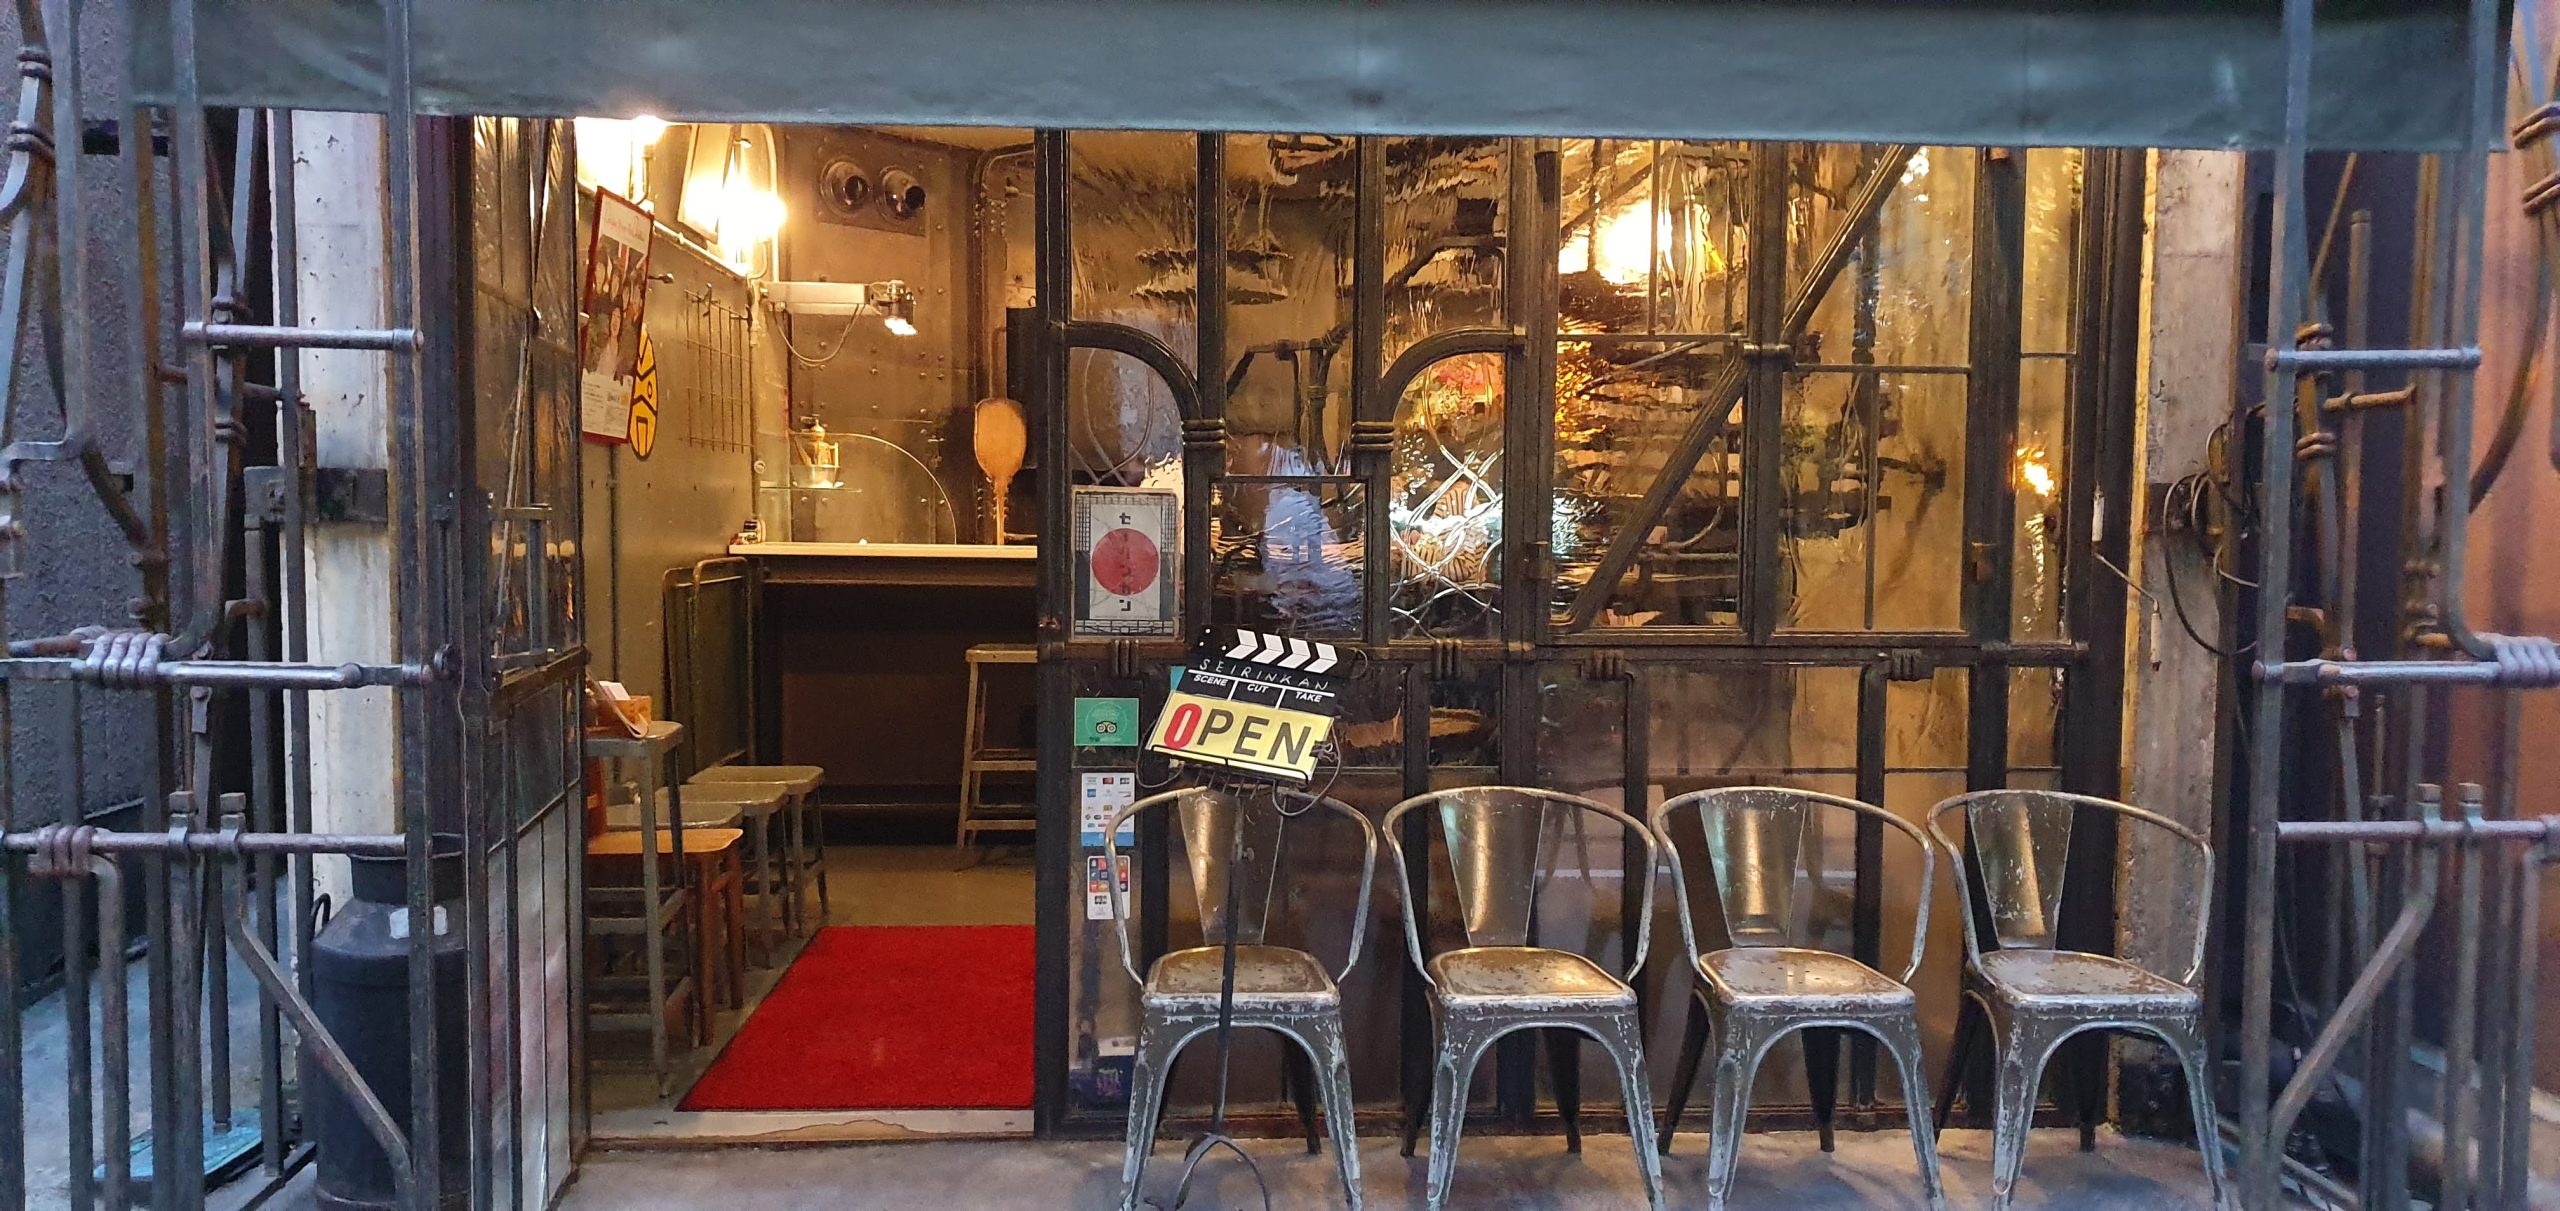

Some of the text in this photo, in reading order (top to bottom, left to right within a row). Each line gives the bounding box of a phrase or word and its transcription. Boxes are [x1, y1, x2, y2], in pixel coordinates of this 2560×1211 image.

[1193, 674, 1229, 687] SCENE
[1199, 658, 1329, 691] SEIRINKAN
[1246, 683, 1269, 694] CUT
[1295, 691, 1323, 703] TAKE
[1163, 703, 1312, 766] OPEN
